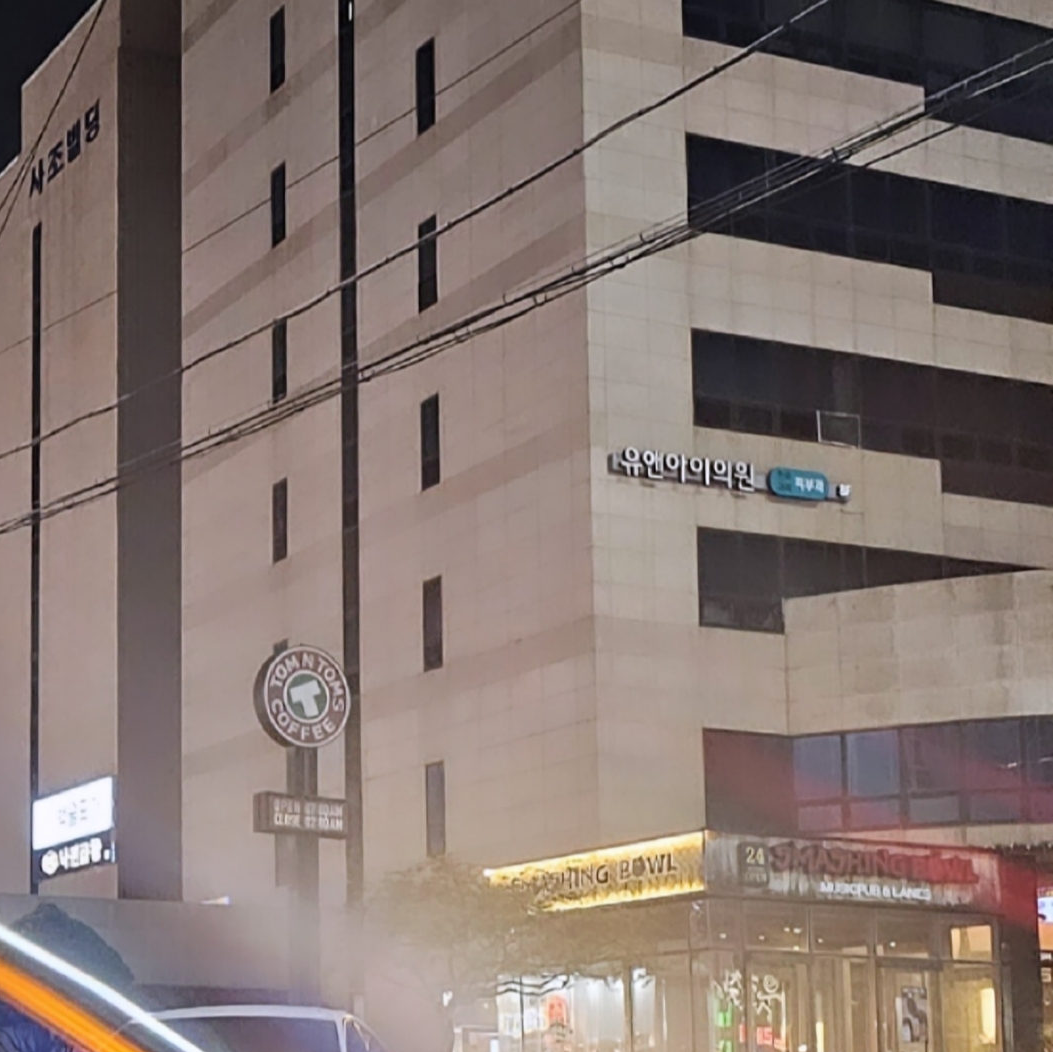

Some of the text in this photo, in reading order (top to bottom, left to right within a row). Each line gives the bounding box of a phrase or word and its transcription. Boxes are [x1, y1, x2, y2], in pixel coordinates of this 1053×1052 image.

[29, 98, 100, 198] 사조빌딩
[621, 446, 755, 492] 유앤아이의원
[270, 652, 345, 712] TOM N TOMS
[271, 698, 337, 741] COFFEE
[619, 852, 678, 880] BOWL
[746, 846, 765, 865] 24
[769, 839, 910, 881] SMASHING
